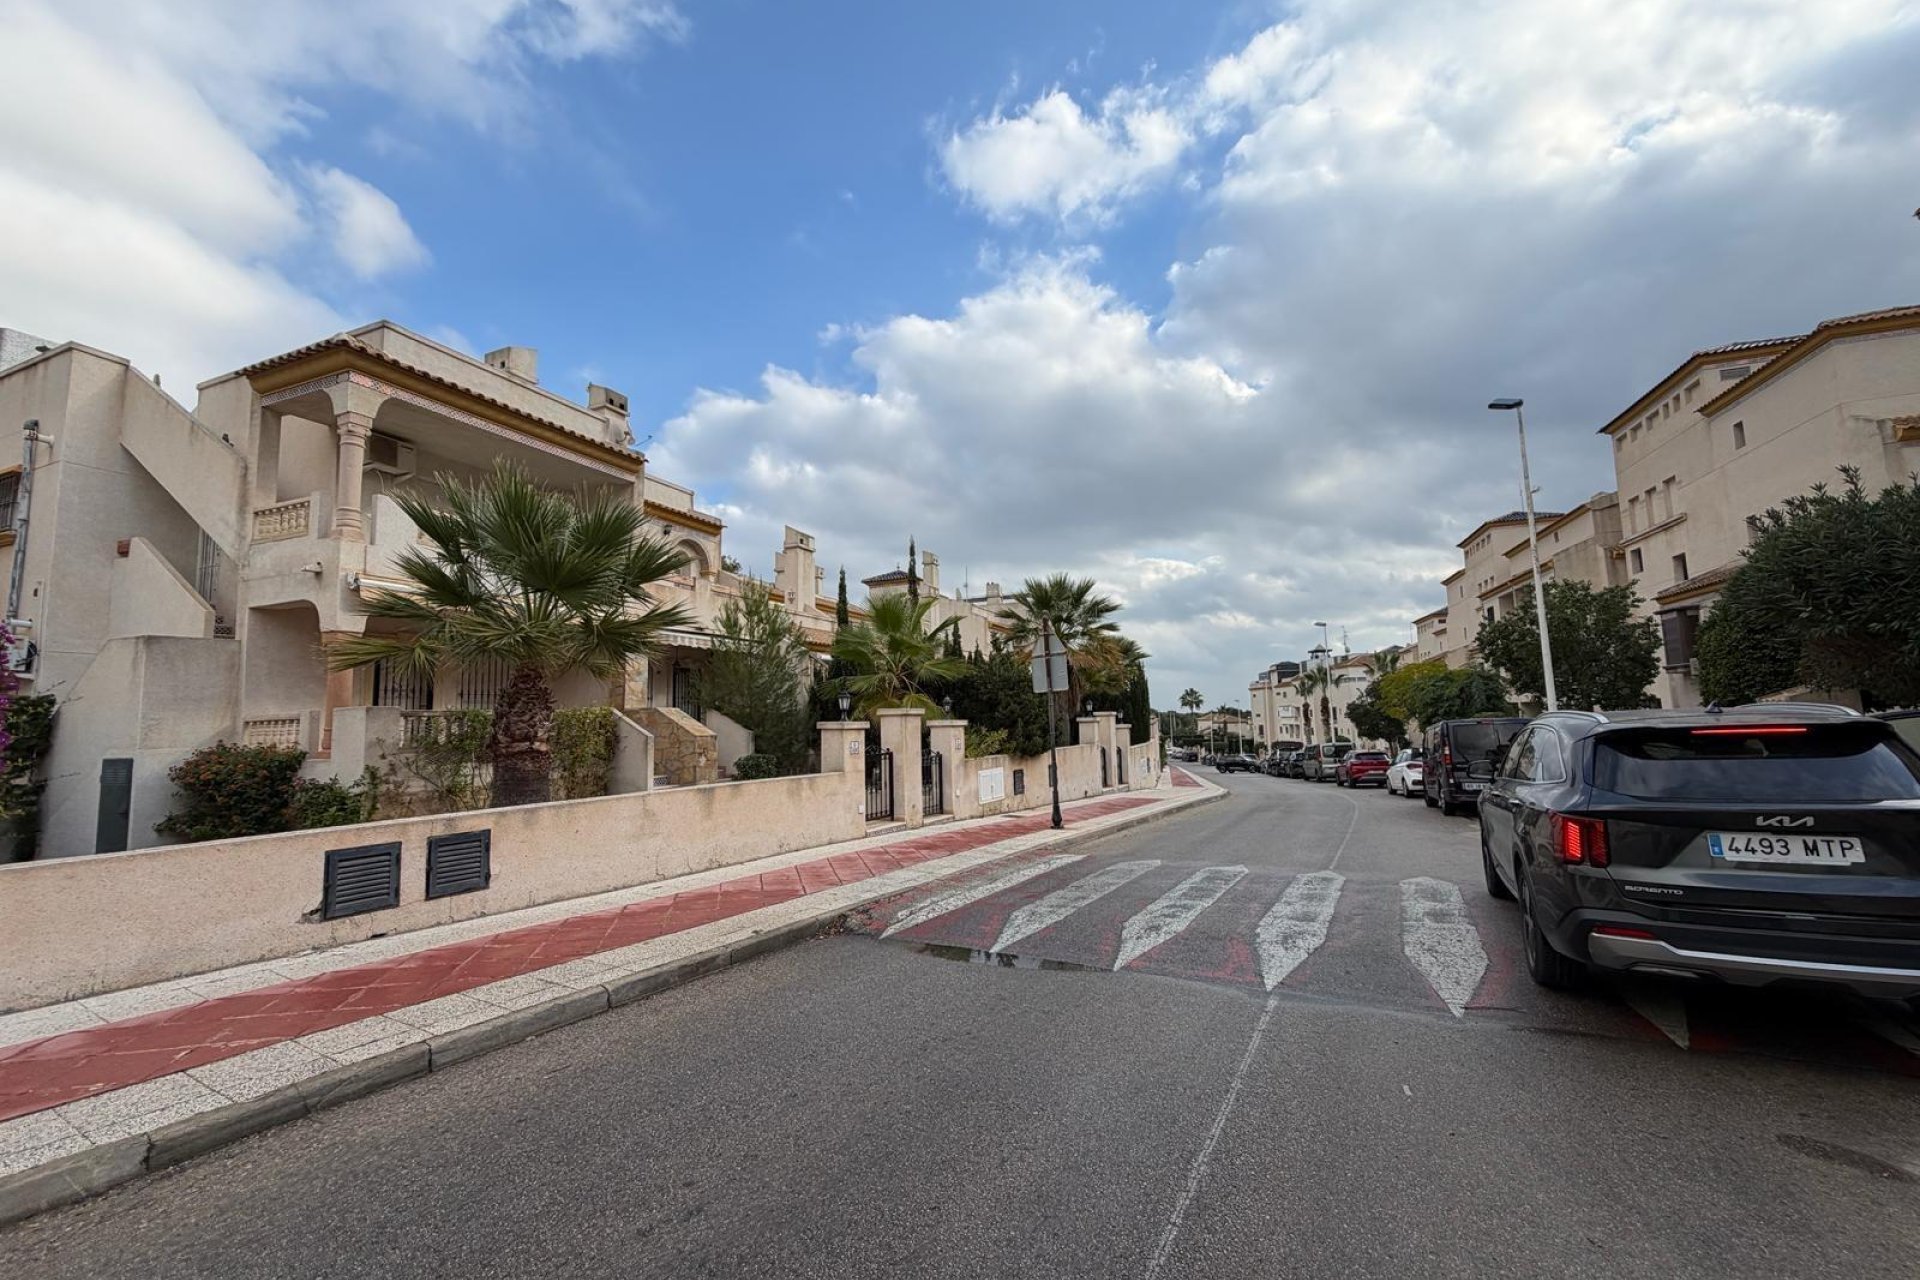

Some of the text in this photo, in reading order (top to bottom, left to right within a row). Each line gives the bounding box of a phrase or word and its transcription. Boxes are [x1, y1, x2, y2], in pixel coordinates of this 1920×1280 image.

[1756, 815, 1814, 827] KIA
[1727, 836, 1855, 858] 4493 MTP
[1624, 885, 1684, 895] SORENTO
